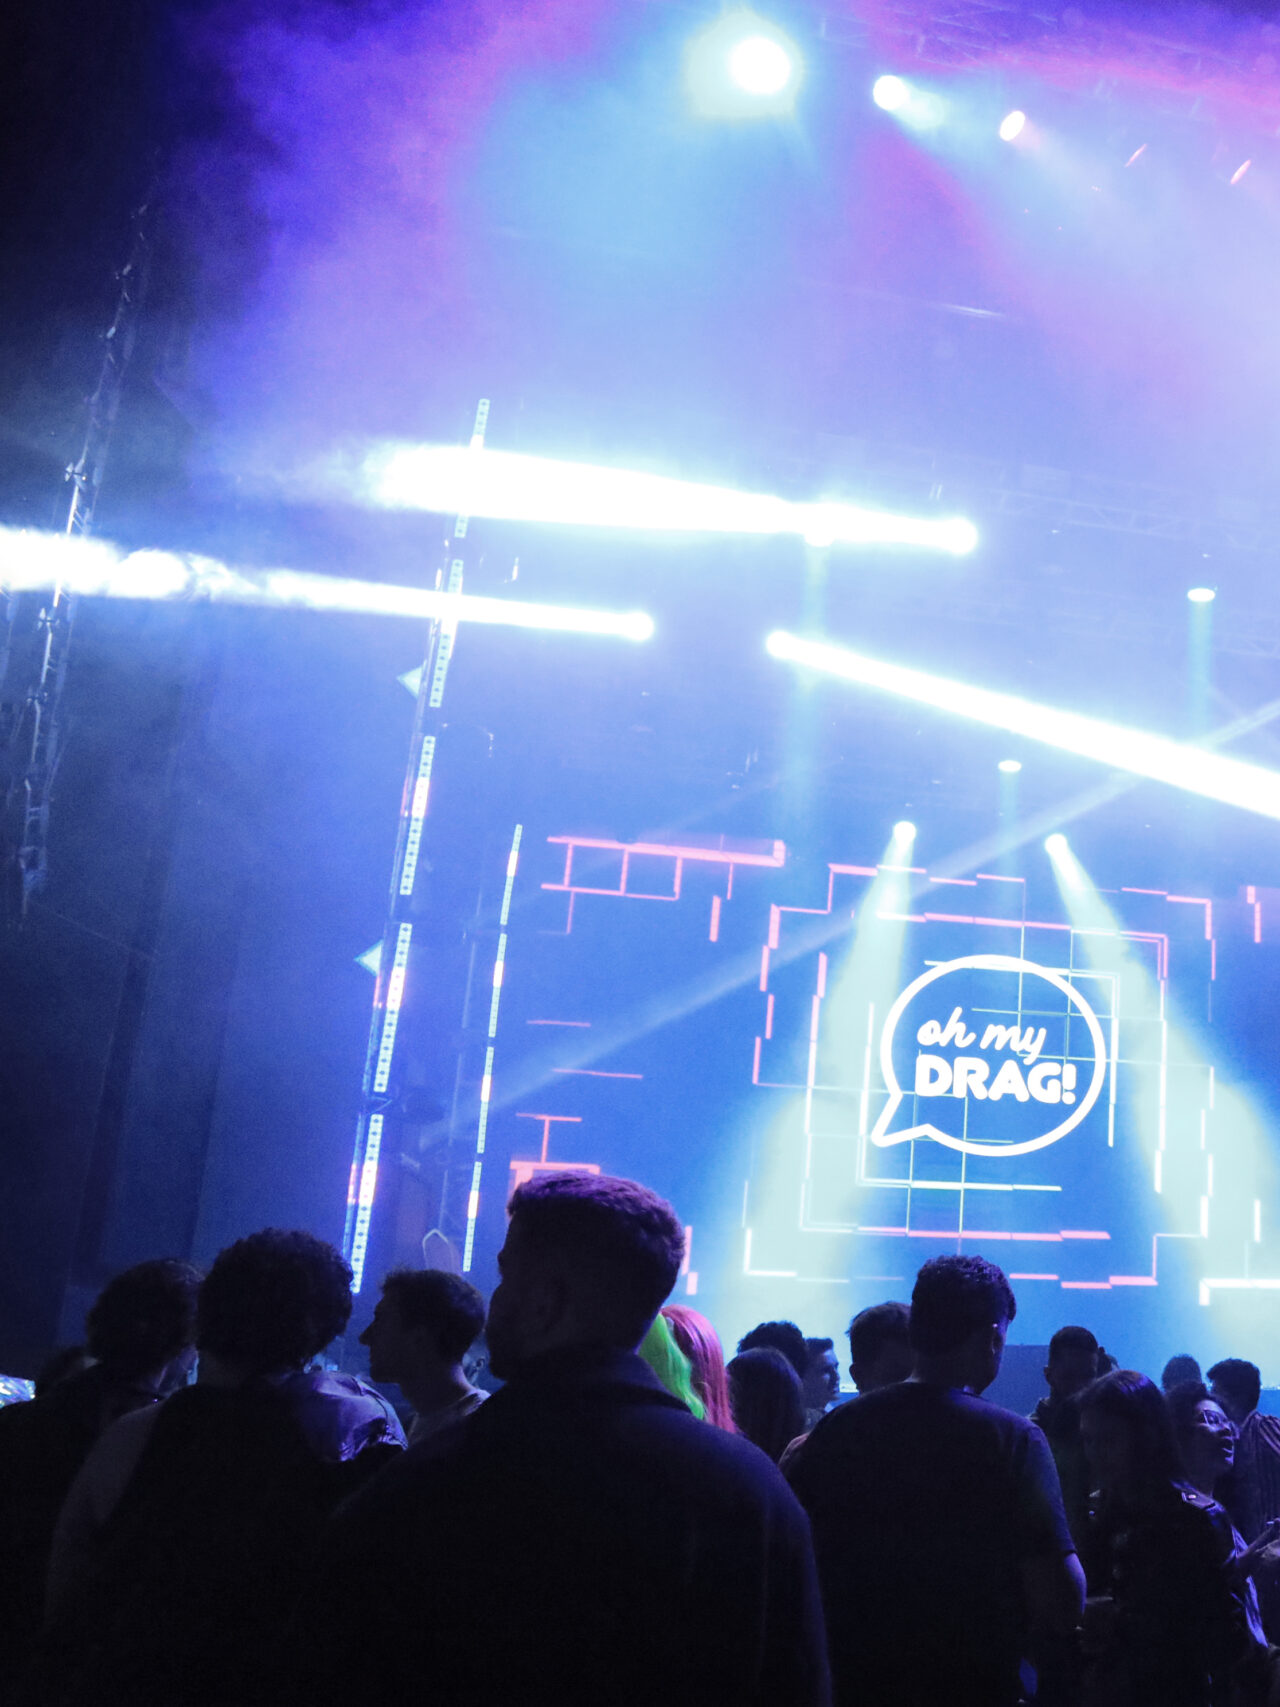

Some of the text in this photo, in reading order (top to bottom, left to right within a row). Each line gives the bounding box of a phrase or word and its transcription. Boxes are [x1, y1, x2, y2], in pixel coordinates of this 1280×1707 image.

[917, 1006, 1047, 1065] oh my
[915, 1054, 1077, 1104] DRAG!
